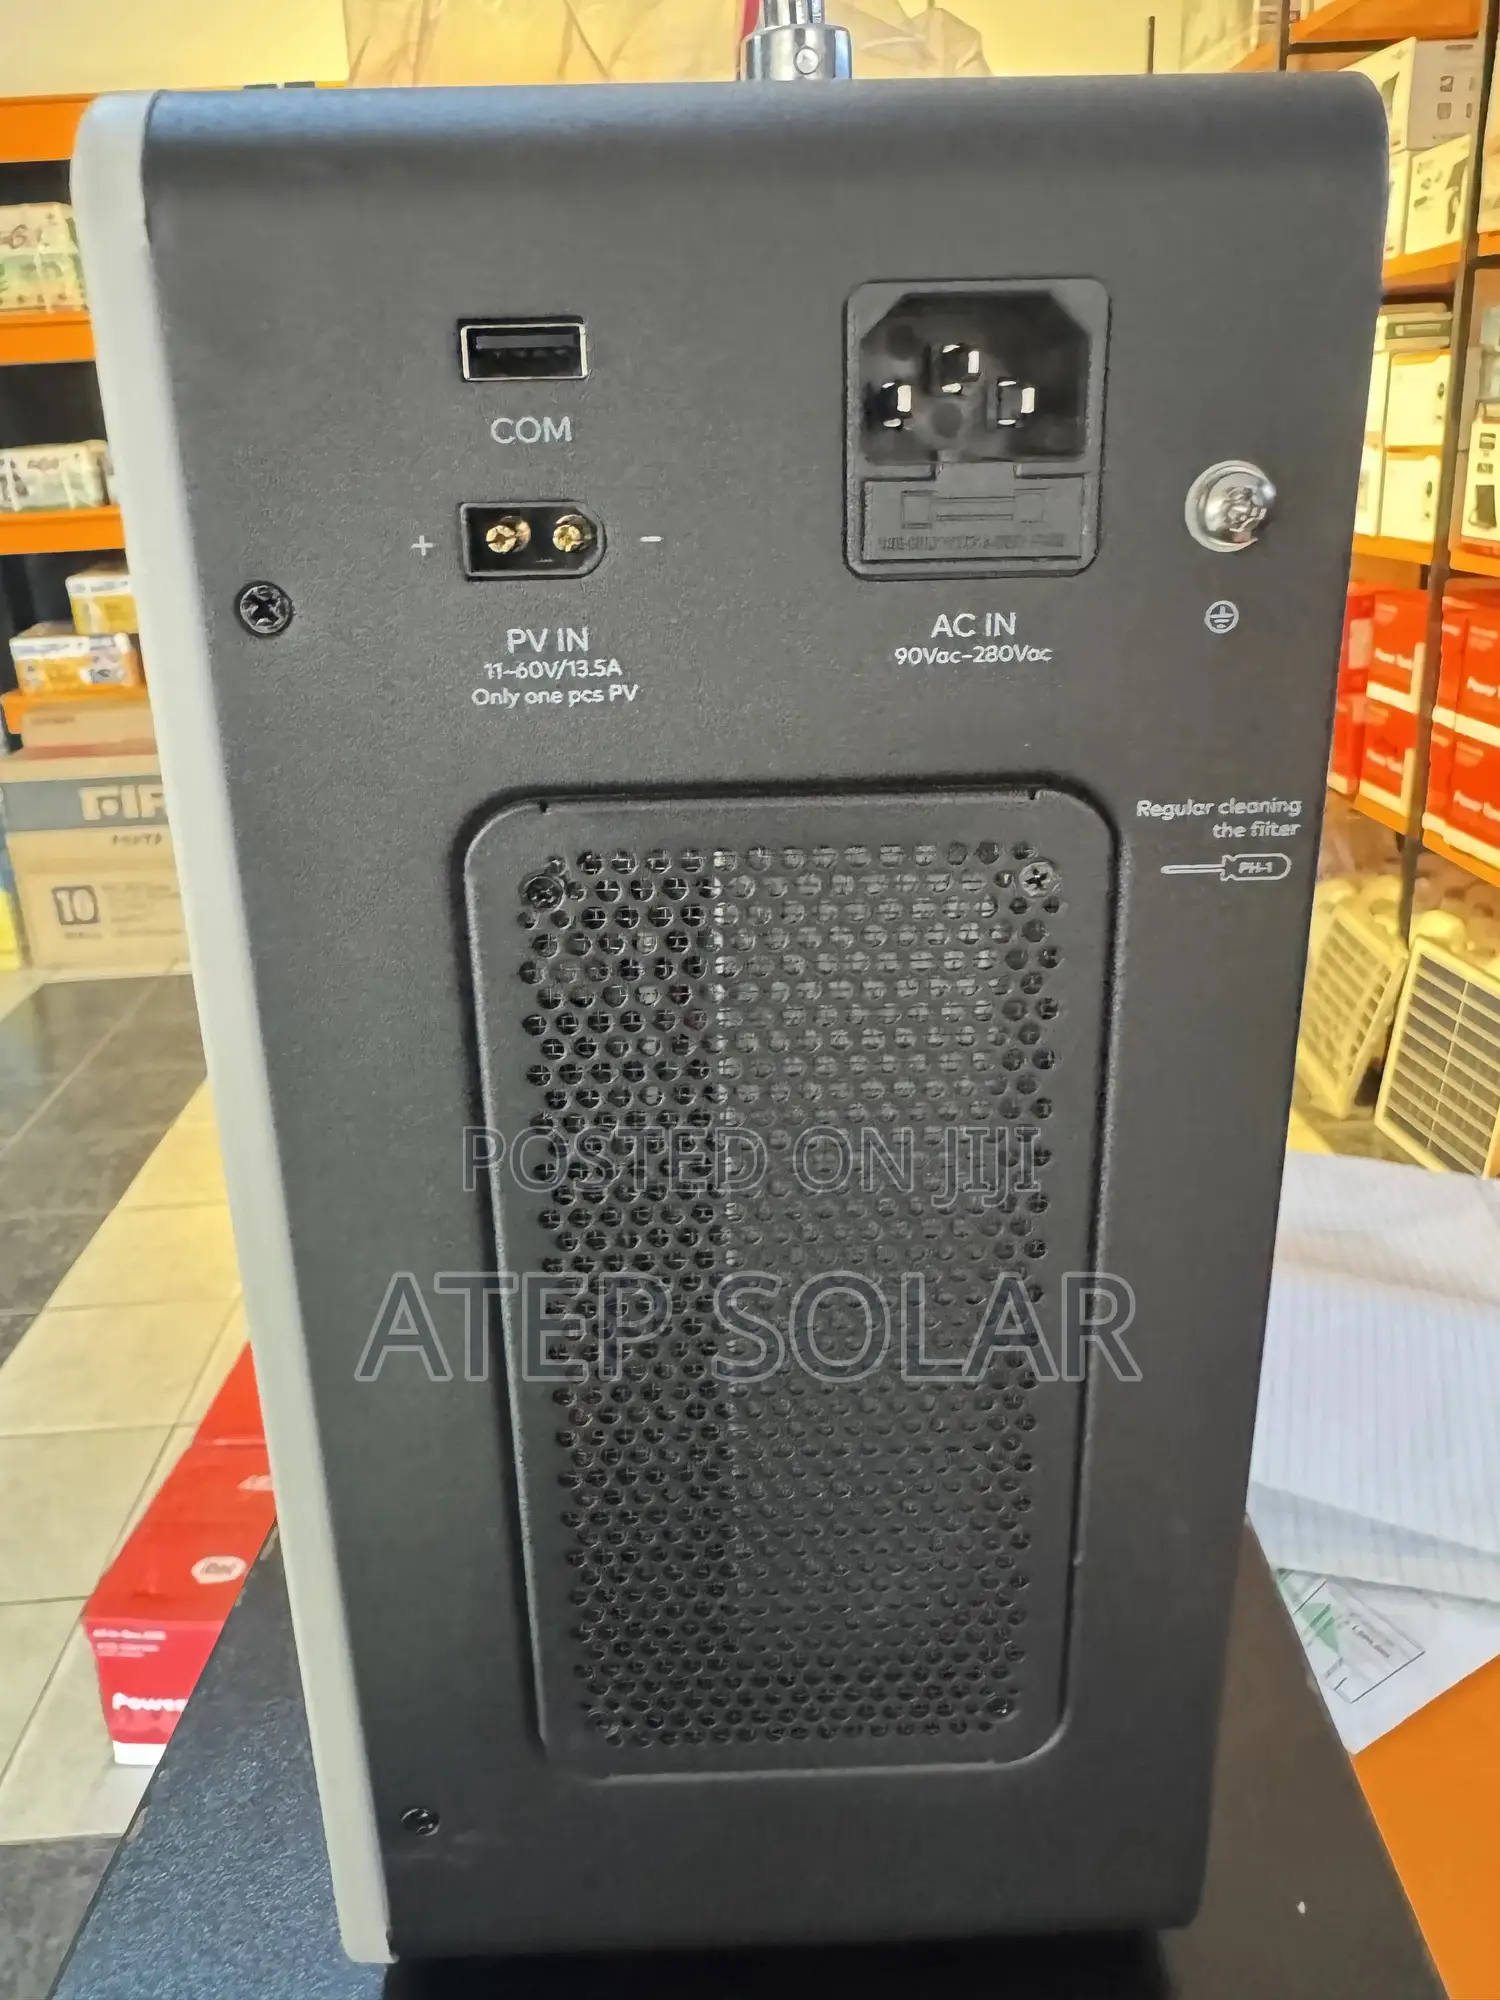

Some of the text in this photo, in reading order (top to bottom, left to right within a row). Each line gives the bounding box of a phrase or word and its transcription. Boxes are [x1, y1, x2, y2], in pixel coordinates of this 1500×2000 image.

[490, 416, 573, 444] COM
[930, 612, 1016, 638] AC IN
[506, 627, 589, 653] PV IN
[894, 644, 1053, 665] 90Vac-280Vac
[471, 683, 639, 709] Only one pcs PV
[1136, 797, 1302, 820] Regular cleaning
[1212, 820, 1301, 839] the filter
